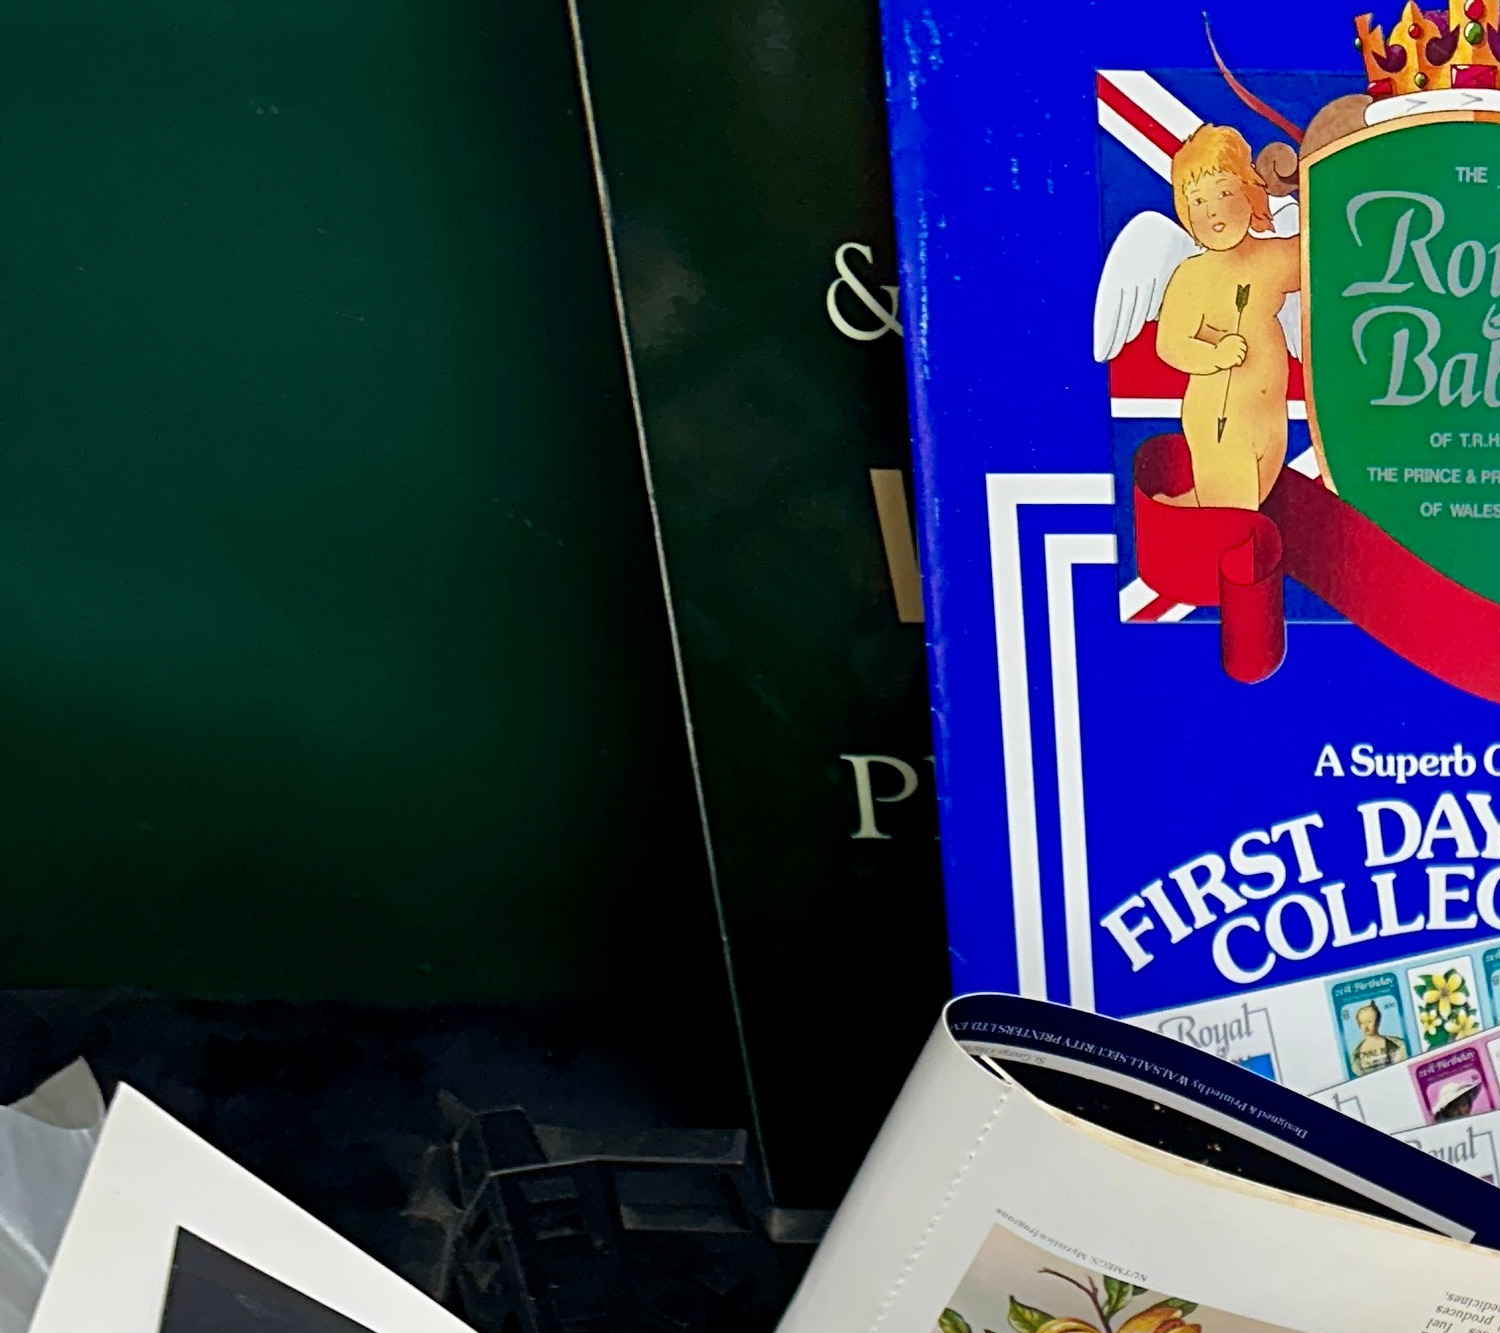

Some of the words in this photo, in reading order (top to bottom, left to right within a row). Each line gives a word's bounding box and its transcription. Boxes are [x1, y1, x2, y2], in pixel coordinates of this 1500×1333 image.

[1455, 167, 1488, 184] THE
[826, 242, 904, 344] &
[1430, 433, 1452, 448] OF
[1366, 466, 1398, 483] THE
[1402, 467, 1460, 485] PRINCE
[1465, 469, 1477, 485] &
[1420, 502, 1442, 518] OF
[1314, 744, 1345, 777] A
[1350, 743, 1475, 784] Superb
[1099, 812, 1325, 973] FIRST
[998, 1024, 1063, 1046] PRINTERS
[1158, 1002, 1253, 1058] Royal
[1130, 1056, 1189, 1086] WALSALL
[1190, 1079, 1211, 1095] by
[1256, 1109, 1308, 1140] Designed
[1426, 1318, 1454, 1333] fuel
[1435, 1305, 1495, 1327] produces
